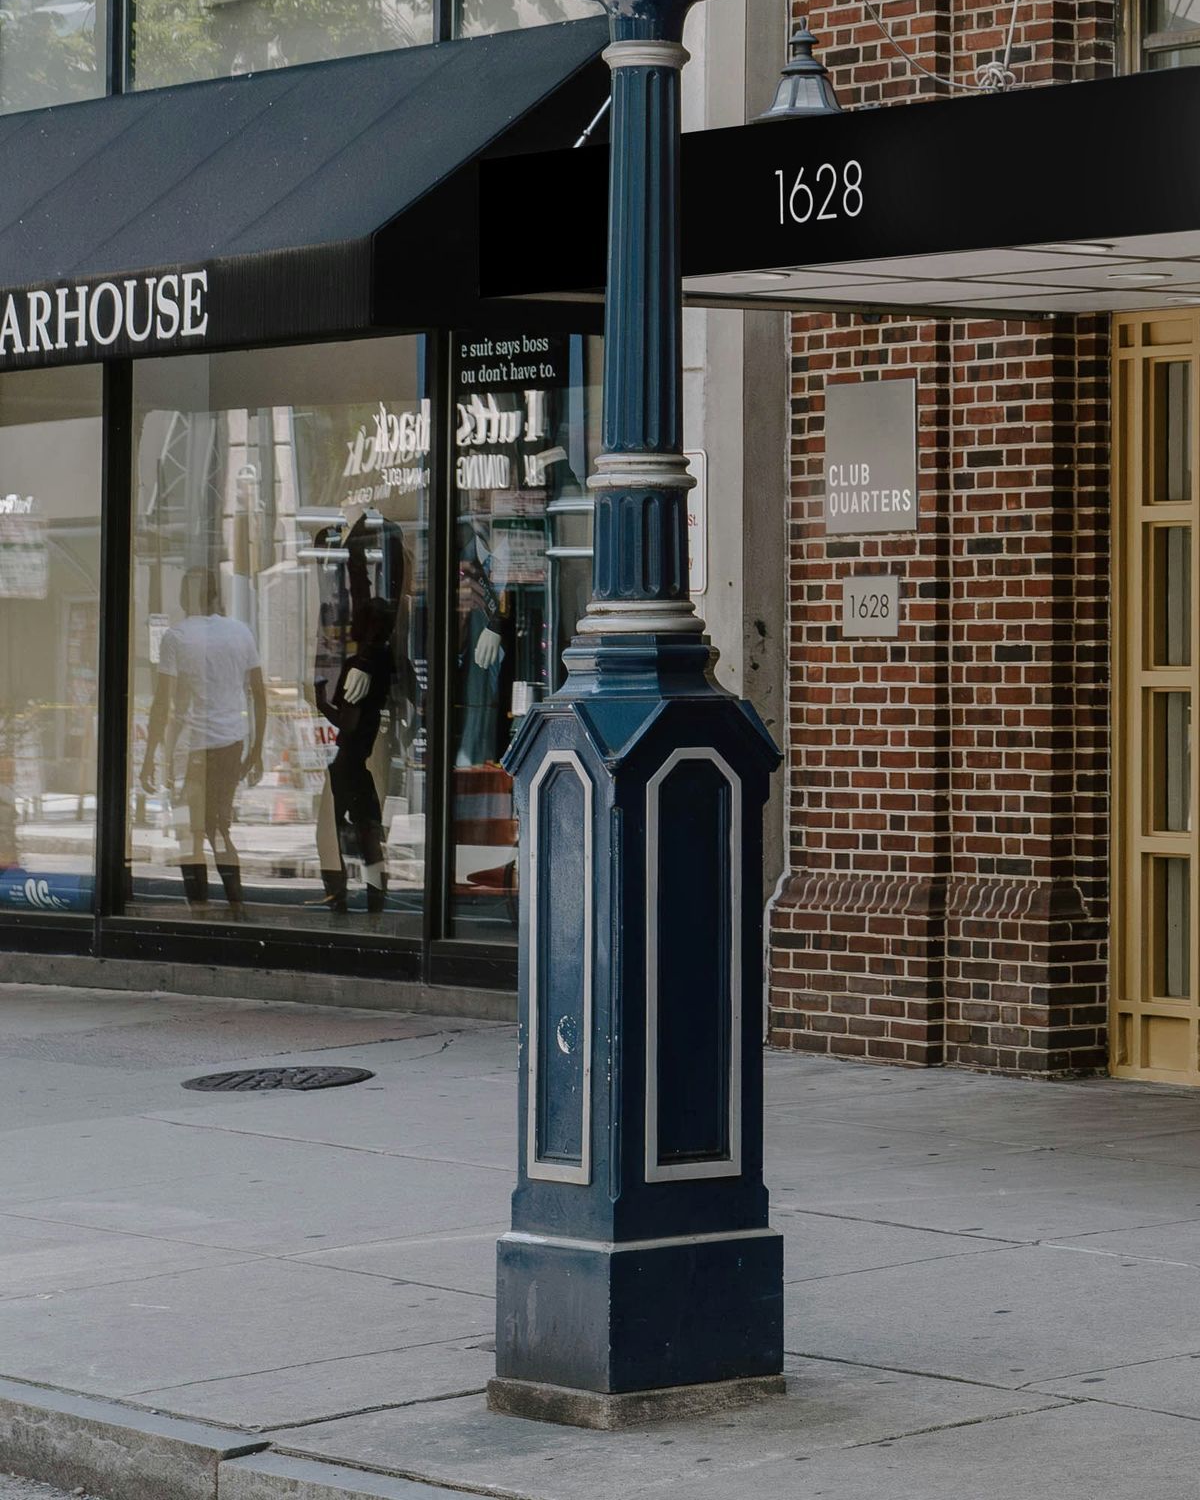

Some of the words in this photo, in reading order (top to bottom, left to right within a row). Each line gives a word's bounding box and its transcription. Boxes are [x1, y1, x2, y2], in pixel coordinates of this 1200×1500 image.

[774, 159, 863, 225] 1628
[0, 269, 208, 355] ARHOUSE
[470, 338, 493, 357] suit
[496, 340, 520, 359] says
[522, 334, 549, 353] boss
[478, 362, 507, 383] don't
[510, 362, 537, 380] have
[540, 362, 556, 378] to.
[829, 463, 870, 487] CLUB
[829, 489, 911, 516] QUARTERS
[850, 593, 890, 618] 1628
